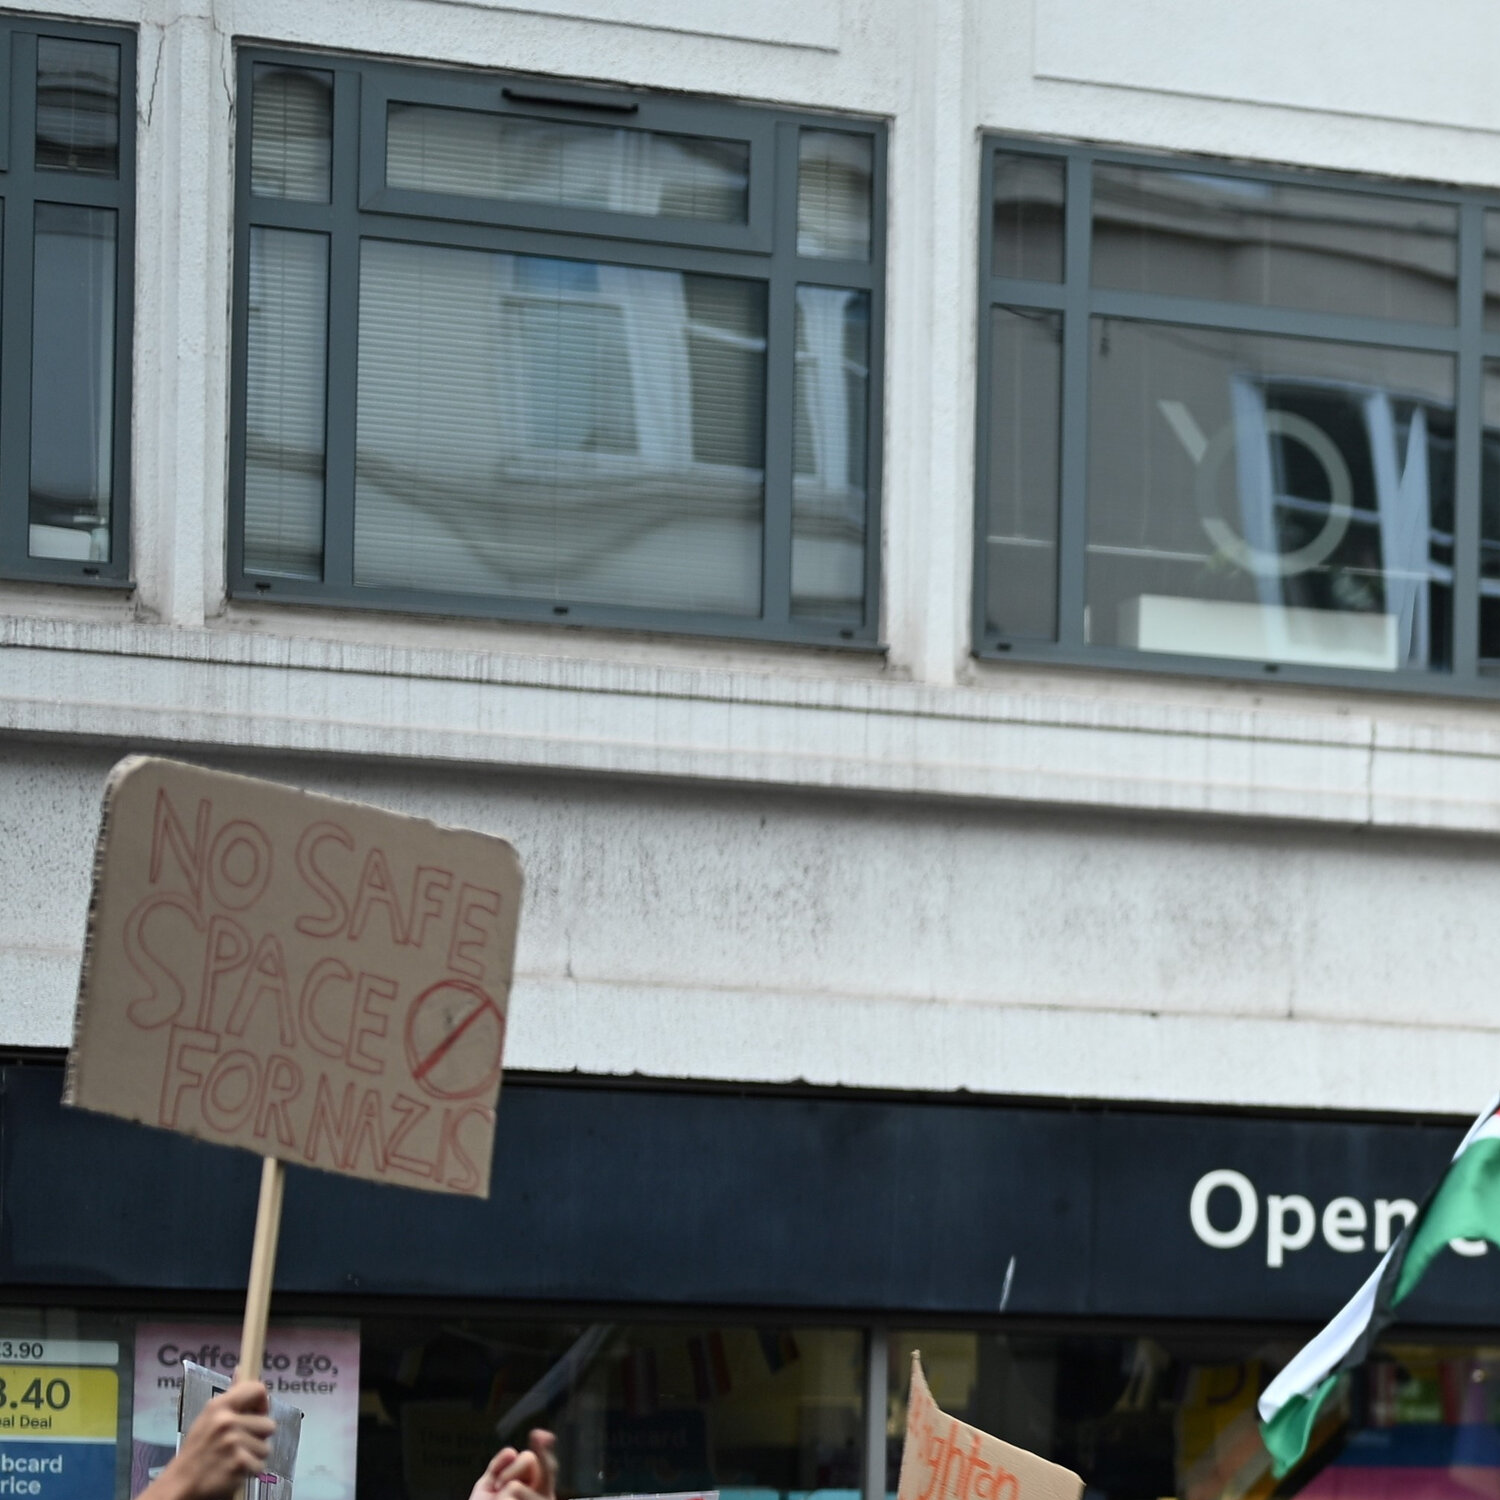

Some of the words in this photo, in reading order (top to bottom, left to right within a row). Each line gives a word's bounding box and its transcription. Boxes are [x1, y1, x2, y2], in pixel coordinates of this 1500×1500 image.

[149, 787, 273, 911] NO
[295, 821, 501, 980] SAFE
[123, 890, 399, 1074] SPACE
[159, 1023, 303, 1146] FOR
[304, 1073, 497, 1192] NAZIS
[1190, 1168, 1419, 1268] Open
[157, 1344, 242, 1370] Coffe
[295, 1352, 339, 1378] go,
[277, 1376, 337, 1394] better
[20, 1415, 52, 1430] Deal
